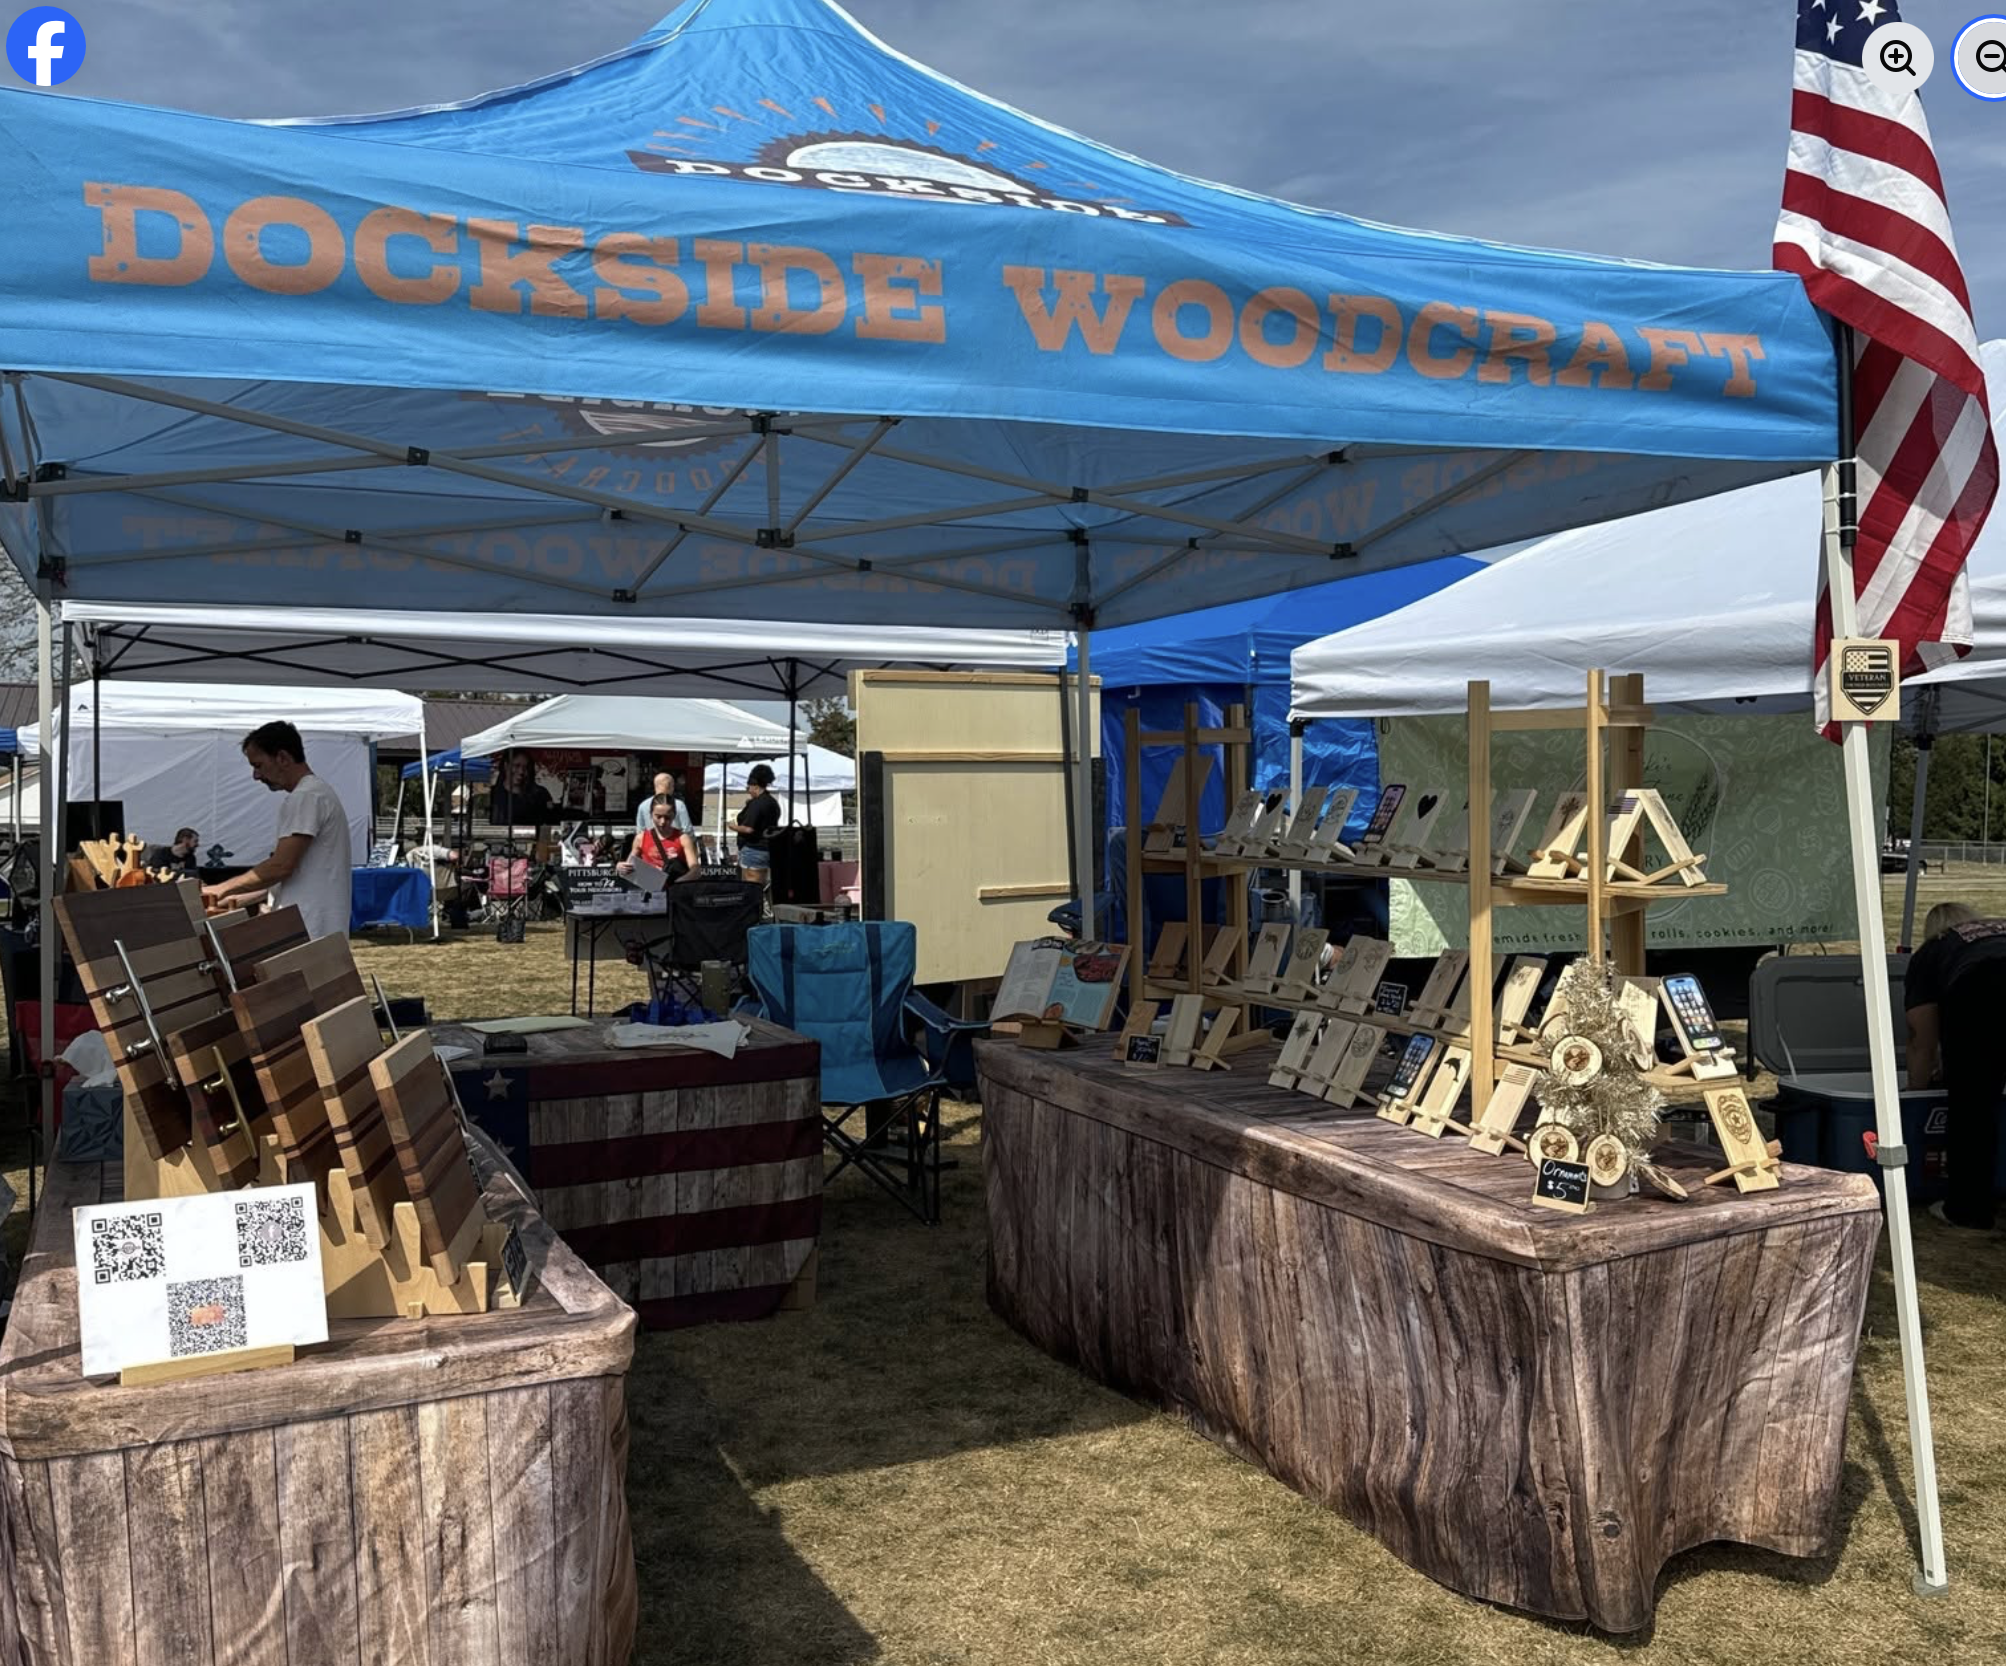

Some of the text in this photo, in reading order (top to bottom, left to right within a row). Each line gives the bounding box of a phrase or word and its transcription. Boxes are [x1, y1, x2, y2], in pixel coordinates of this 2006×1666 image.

[84, 181, 1766, 399] DOCKSIDE WOODCRAFT
[1768, 923, 1794, 935] and
